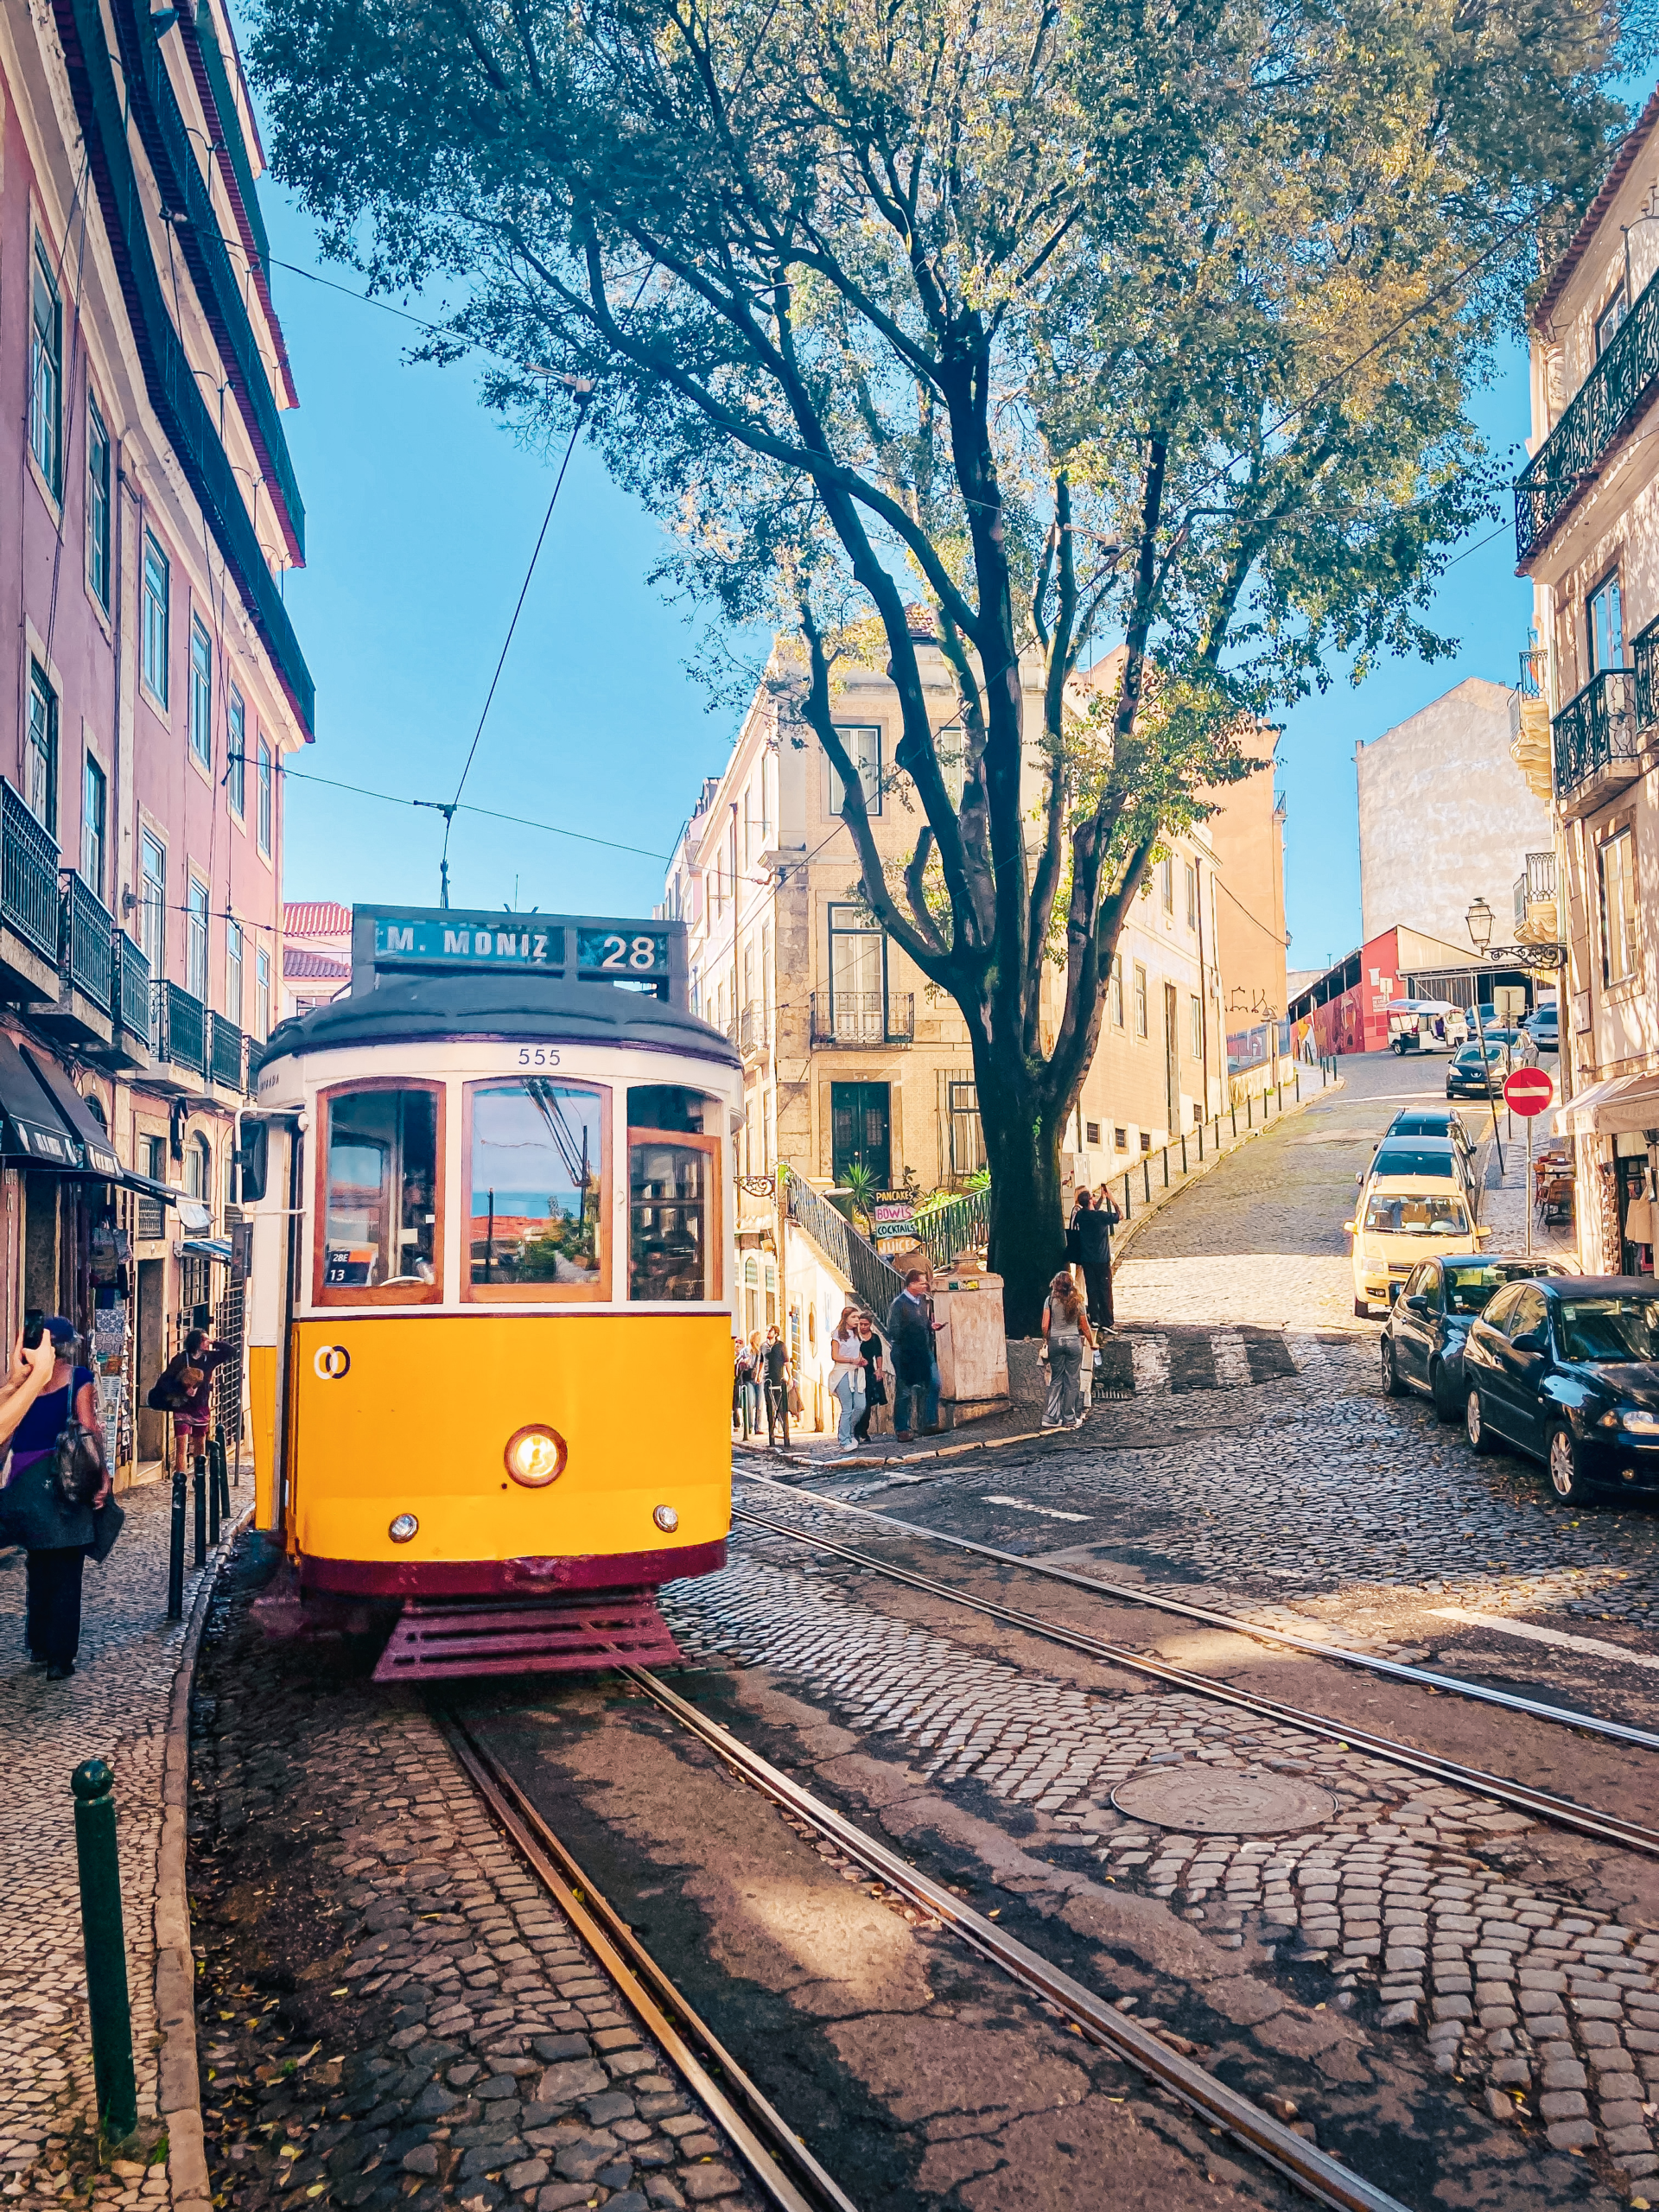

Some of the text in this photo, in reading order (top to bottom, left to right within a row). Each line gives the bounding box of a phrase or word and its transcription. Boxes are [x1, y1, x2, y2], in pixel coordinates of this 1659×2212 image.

[387, 926, 548, 957] M. MONIZ
[601, 937, 655, 969] 28
[518, 1048, 561, 1066] 555
[876, 1191, 913, 1202] PANCAKES
[877, 1207, 912, 1219] BOWLS
[333, 1253, 349, 1262] 28E
[331, 1269, 345, 1281] 13
